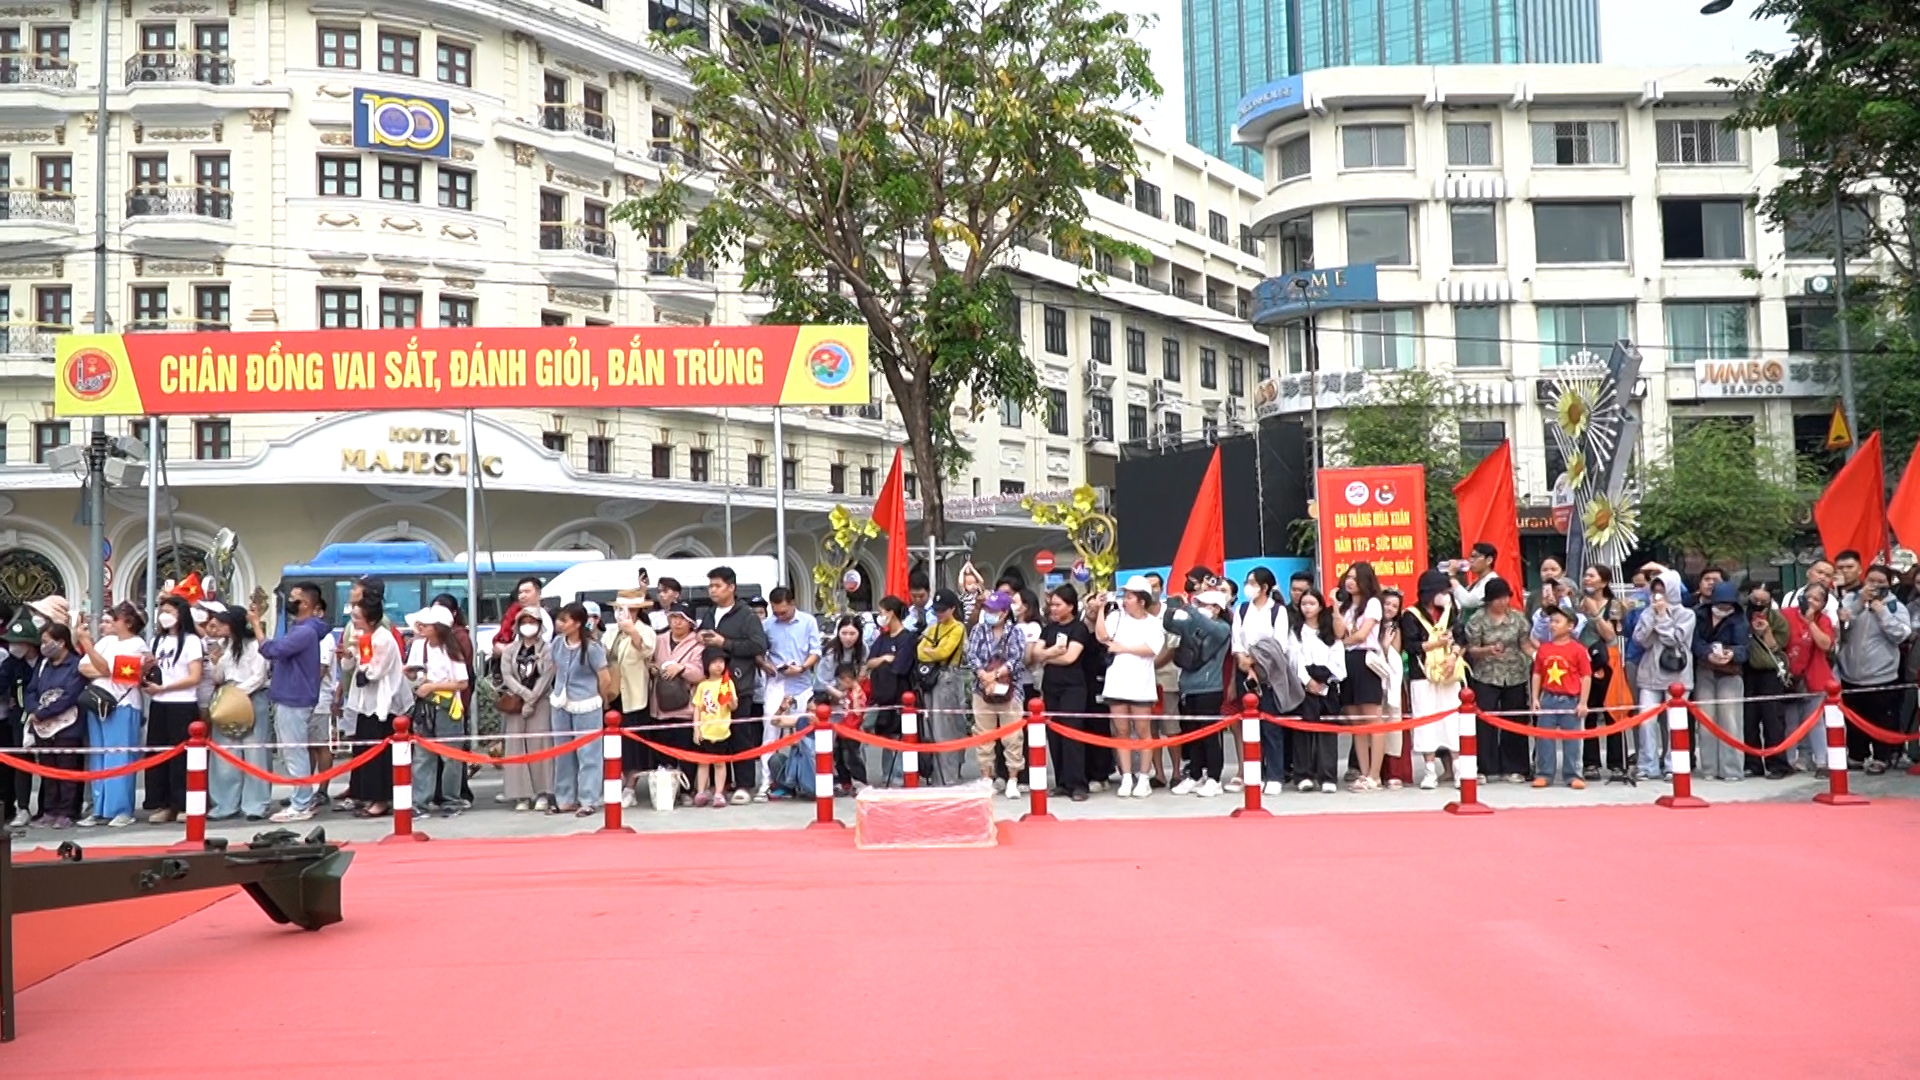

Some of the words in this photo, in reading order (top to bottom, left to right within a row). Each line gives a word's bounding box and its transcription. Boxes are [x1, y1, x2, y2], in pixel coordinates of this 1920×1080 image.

[361, 93, 445, 150] 100
[160, 346, 238, 394] CHÂN
[246, 340, 324, 391] ĐỒNG
[332, 351, 375, 390] VAI
[384, 335, 441, 392] SẮT,
[450, 341, 527, 387] ĐÁNH
[535, 336, 599, 391] GIỎI,
[608, 334, 665, 386] BẮN
[673, 340, 764, 386] TRÚNG
[1722, 383, 1784, 395] SEAFOOD
[389, 426, 461, 446] HOTEL
[341, 448, 504, 479] MAJESTC
[1335, 513, 1348, 532] ĐẠI
[1348, 507, 1372, 529] THẮNG
[1373, 509, 1389, 527] MÙA
[1390, 507, 1410, 527] XUÂN
[1334, 535, 1352, 553] NĂM
[1352, 536, 1370, 552] 1975
[1376, 533, 1390, 552] SỨC
[1391, 535, 1413, 554] MẠNH
[1395, 555, 1414, 576] NHẤT
